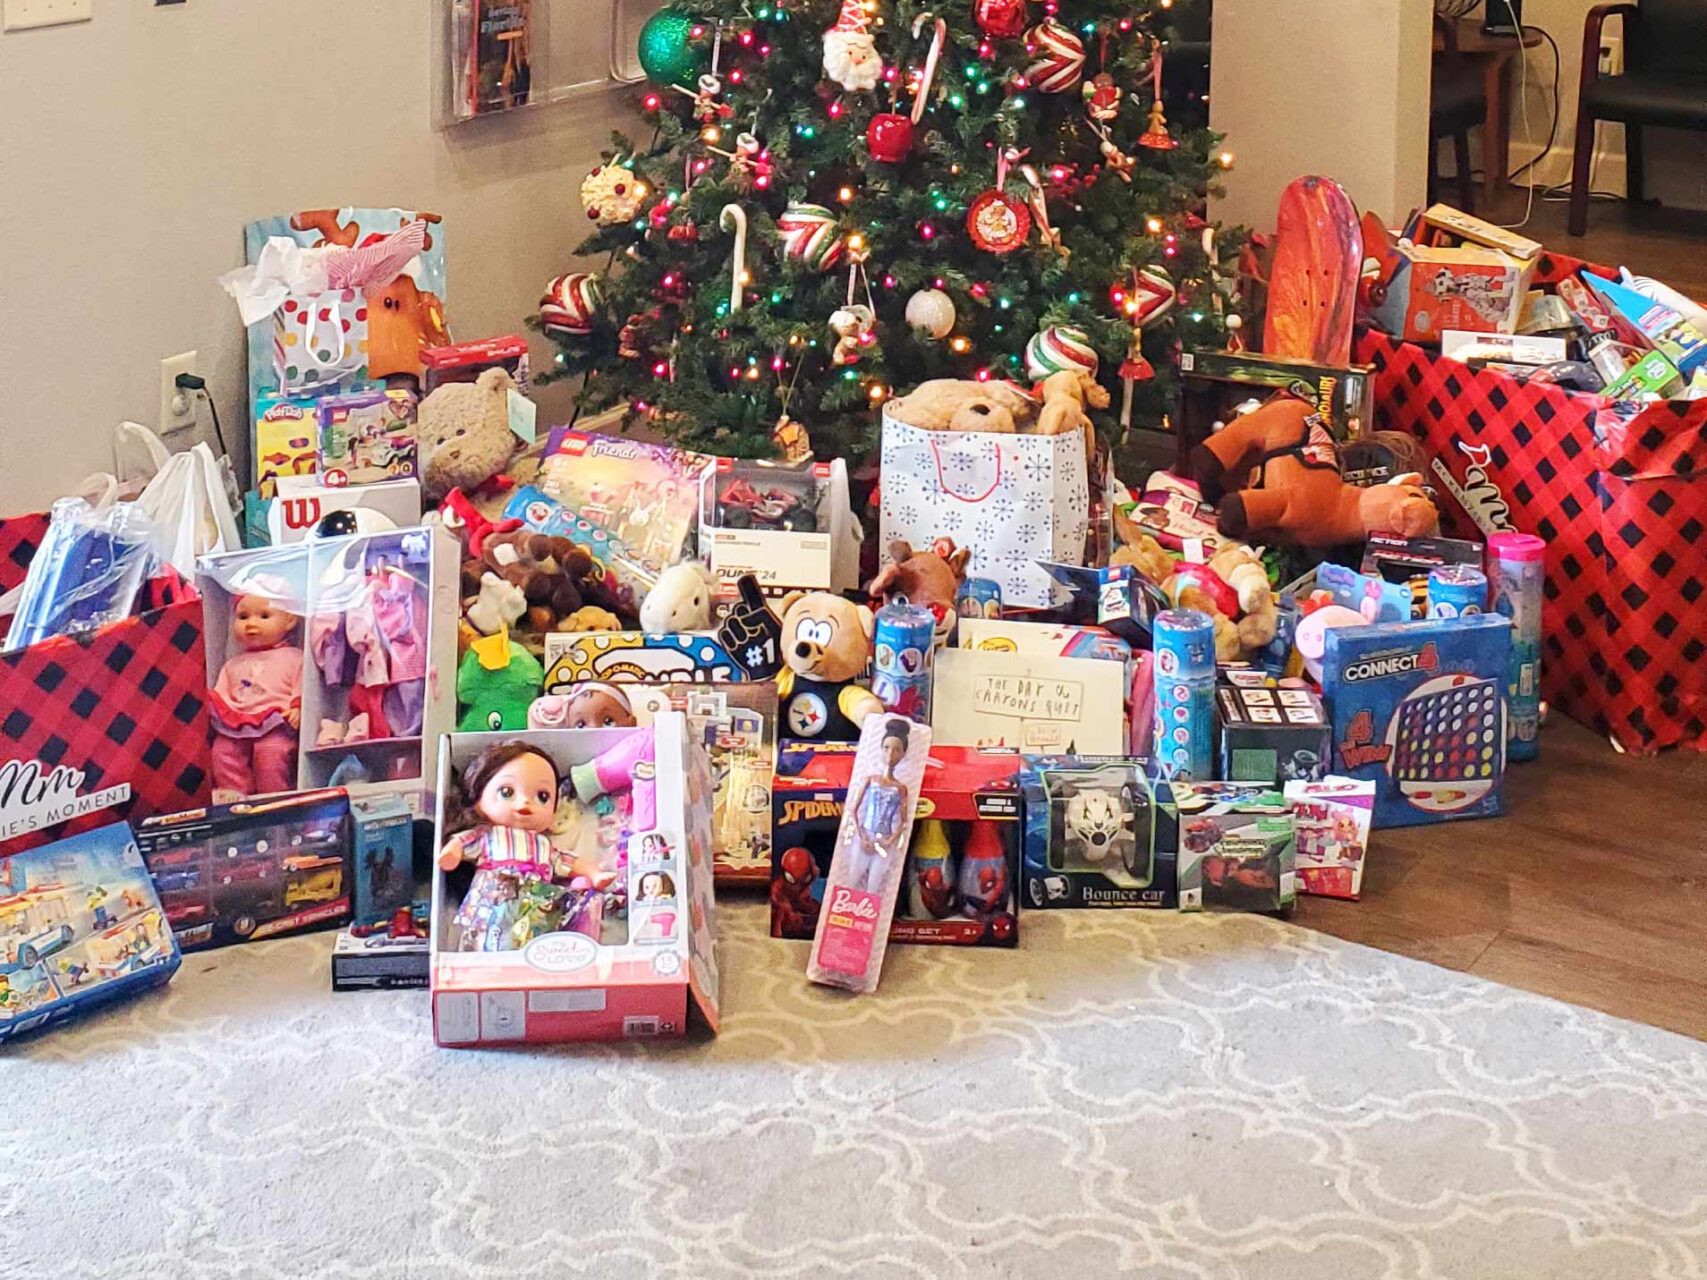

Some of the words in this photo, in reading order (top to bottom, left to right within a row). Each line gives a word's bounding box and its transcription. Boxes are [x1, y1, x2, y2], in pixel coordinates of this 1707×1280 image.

[745, 637, 776, 668] #1
[1344, 653, 1419, 681] CONNECT
[1416, 641, 1439, 672] 4
[987, 677, 1008, 691] THE
[1017, 679, 1045, 698] DAY
[46, 786, 128, 821] MOMENT
[831, 889, 878, 918] Barbie
[1083, 886, 1138, 901] Bounce
[1141, 890, 1166, 901] car
